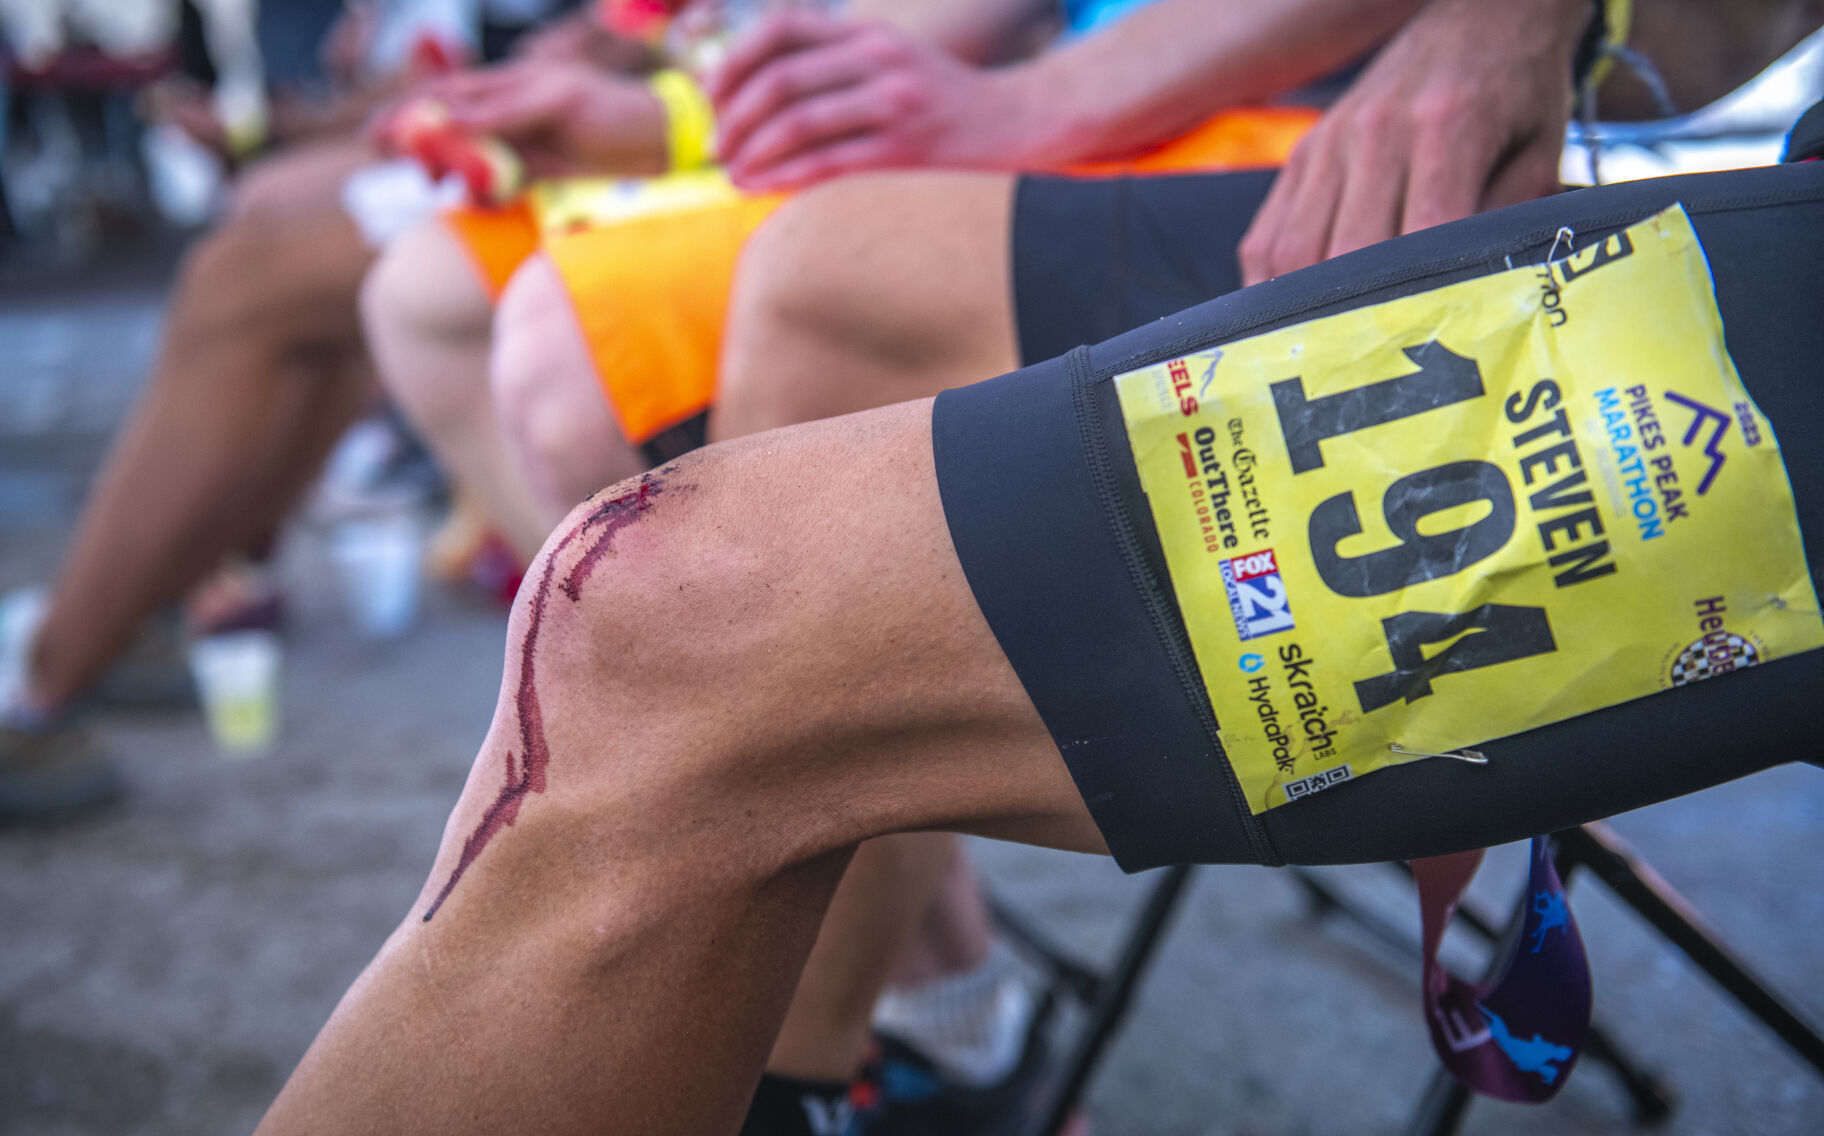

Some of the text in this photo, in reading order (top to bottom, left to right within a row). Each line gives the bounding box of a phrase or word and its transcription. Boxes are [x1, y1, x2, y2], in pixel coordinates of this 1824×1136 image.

[1194, 426, 1239, 549] OutThere
[1227, 416, 1271, 539] The Gazette
[1504, 378, 1618, 589] STEVEN
[1593, 387, 1665, 541] MARATHON
[1625, 384, 1689, 523] PIKES PEAK
[1189, 480, 1220, 553] COLORADO
[1232, 551, 1276, 579] FOX
[1270, 339, 1558, 714] 194
[1220, 562, 1250, 638] LOCAL NEWS
[1236, 575, 1295, 635] 21
[1248, 676, 1296, 771] HydraPak
[1279, 643, 1338, 751] skratch
[1314, 748, 1337, 761] LABS
